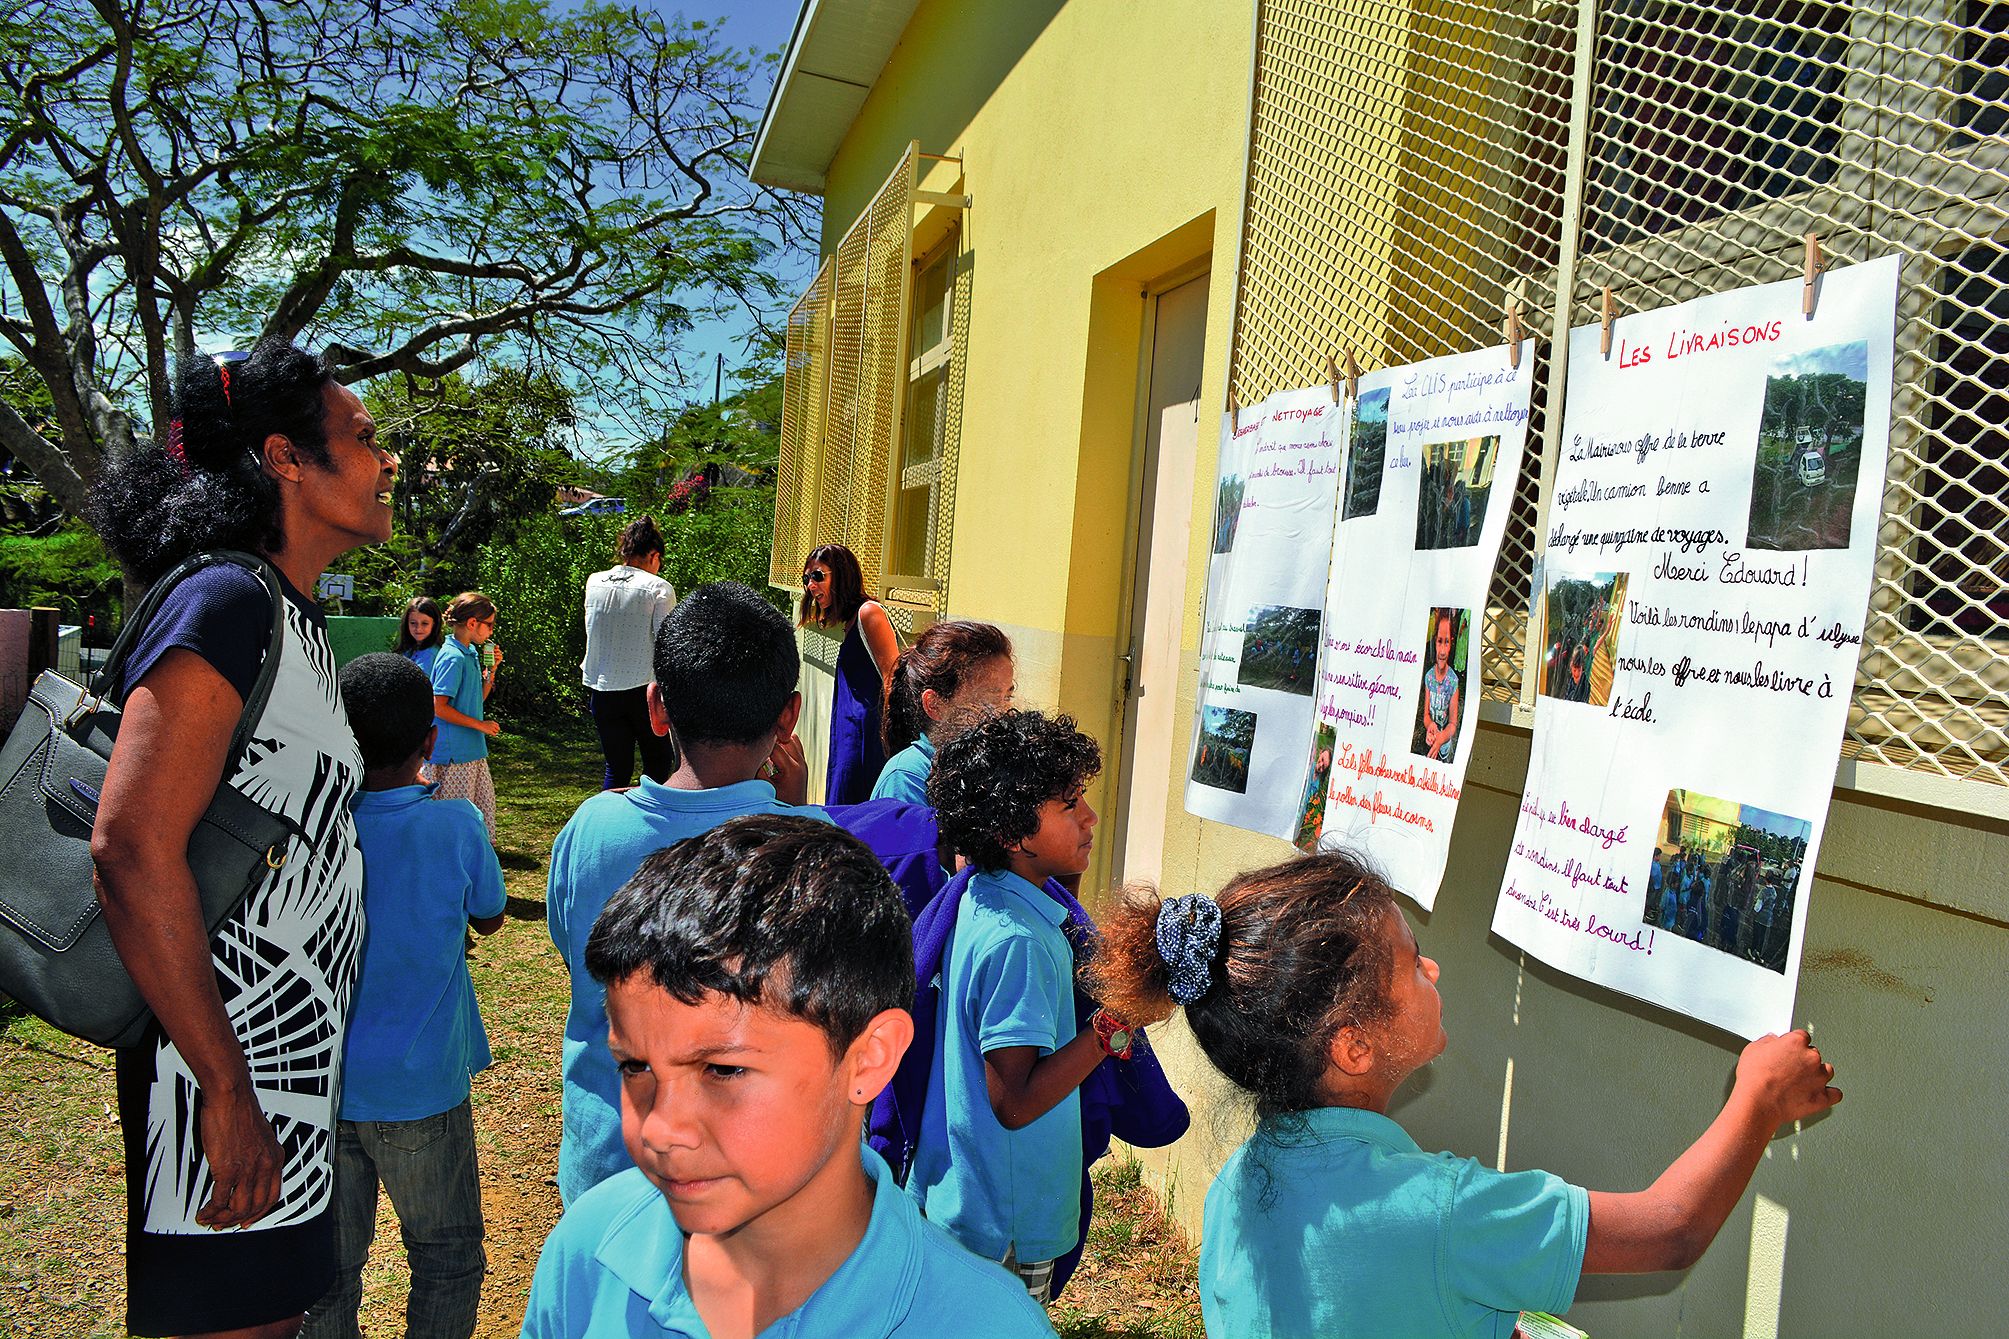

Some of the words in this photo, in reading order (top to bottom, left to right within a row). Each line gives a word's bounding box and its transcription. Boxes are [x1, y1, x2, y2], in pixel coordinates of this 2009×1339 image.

[1447, 372, 1492, 404] participe
[1272, 405, 1325, 424] NETTOYAGE
[1663, 428, 1675, 449] de
[1603, 483, 1646, 501] camion
[1656, 475, 1692, 497] benne
[1698, 480, 1710, 493] a
[1582, 533, 1599, 545] une
[1651, 526, 1667, 543] de
[1667, 528, 1729, 553] voyages.
[1653, 551, 1709, 583] Merci
[1629, 600, 1661, 626] Voilà
[1663, 608, 1677, 628] les
[1754, 620, 1792, 649] papa
[1618, 657, 1646, 675] nous
[1646, 657, 1666, 676] les
[1672, 655, 1706, 687] offre
[1706, 669, 1722, 683] et
[1724, 667, 1752, 688] nous
[1752, 661, 1769, 689] les
[1770, 671, 1814, 697] livre
[1818, 674, 1833, 698] à
[1578, 815, 1629, 850] chargé
[1561, 857, 1574, 878] il
[1572, 862, 1601, 889] faut
[1602, 876, 1629, 894] tout
[1560, 908, 1581, 932] très
